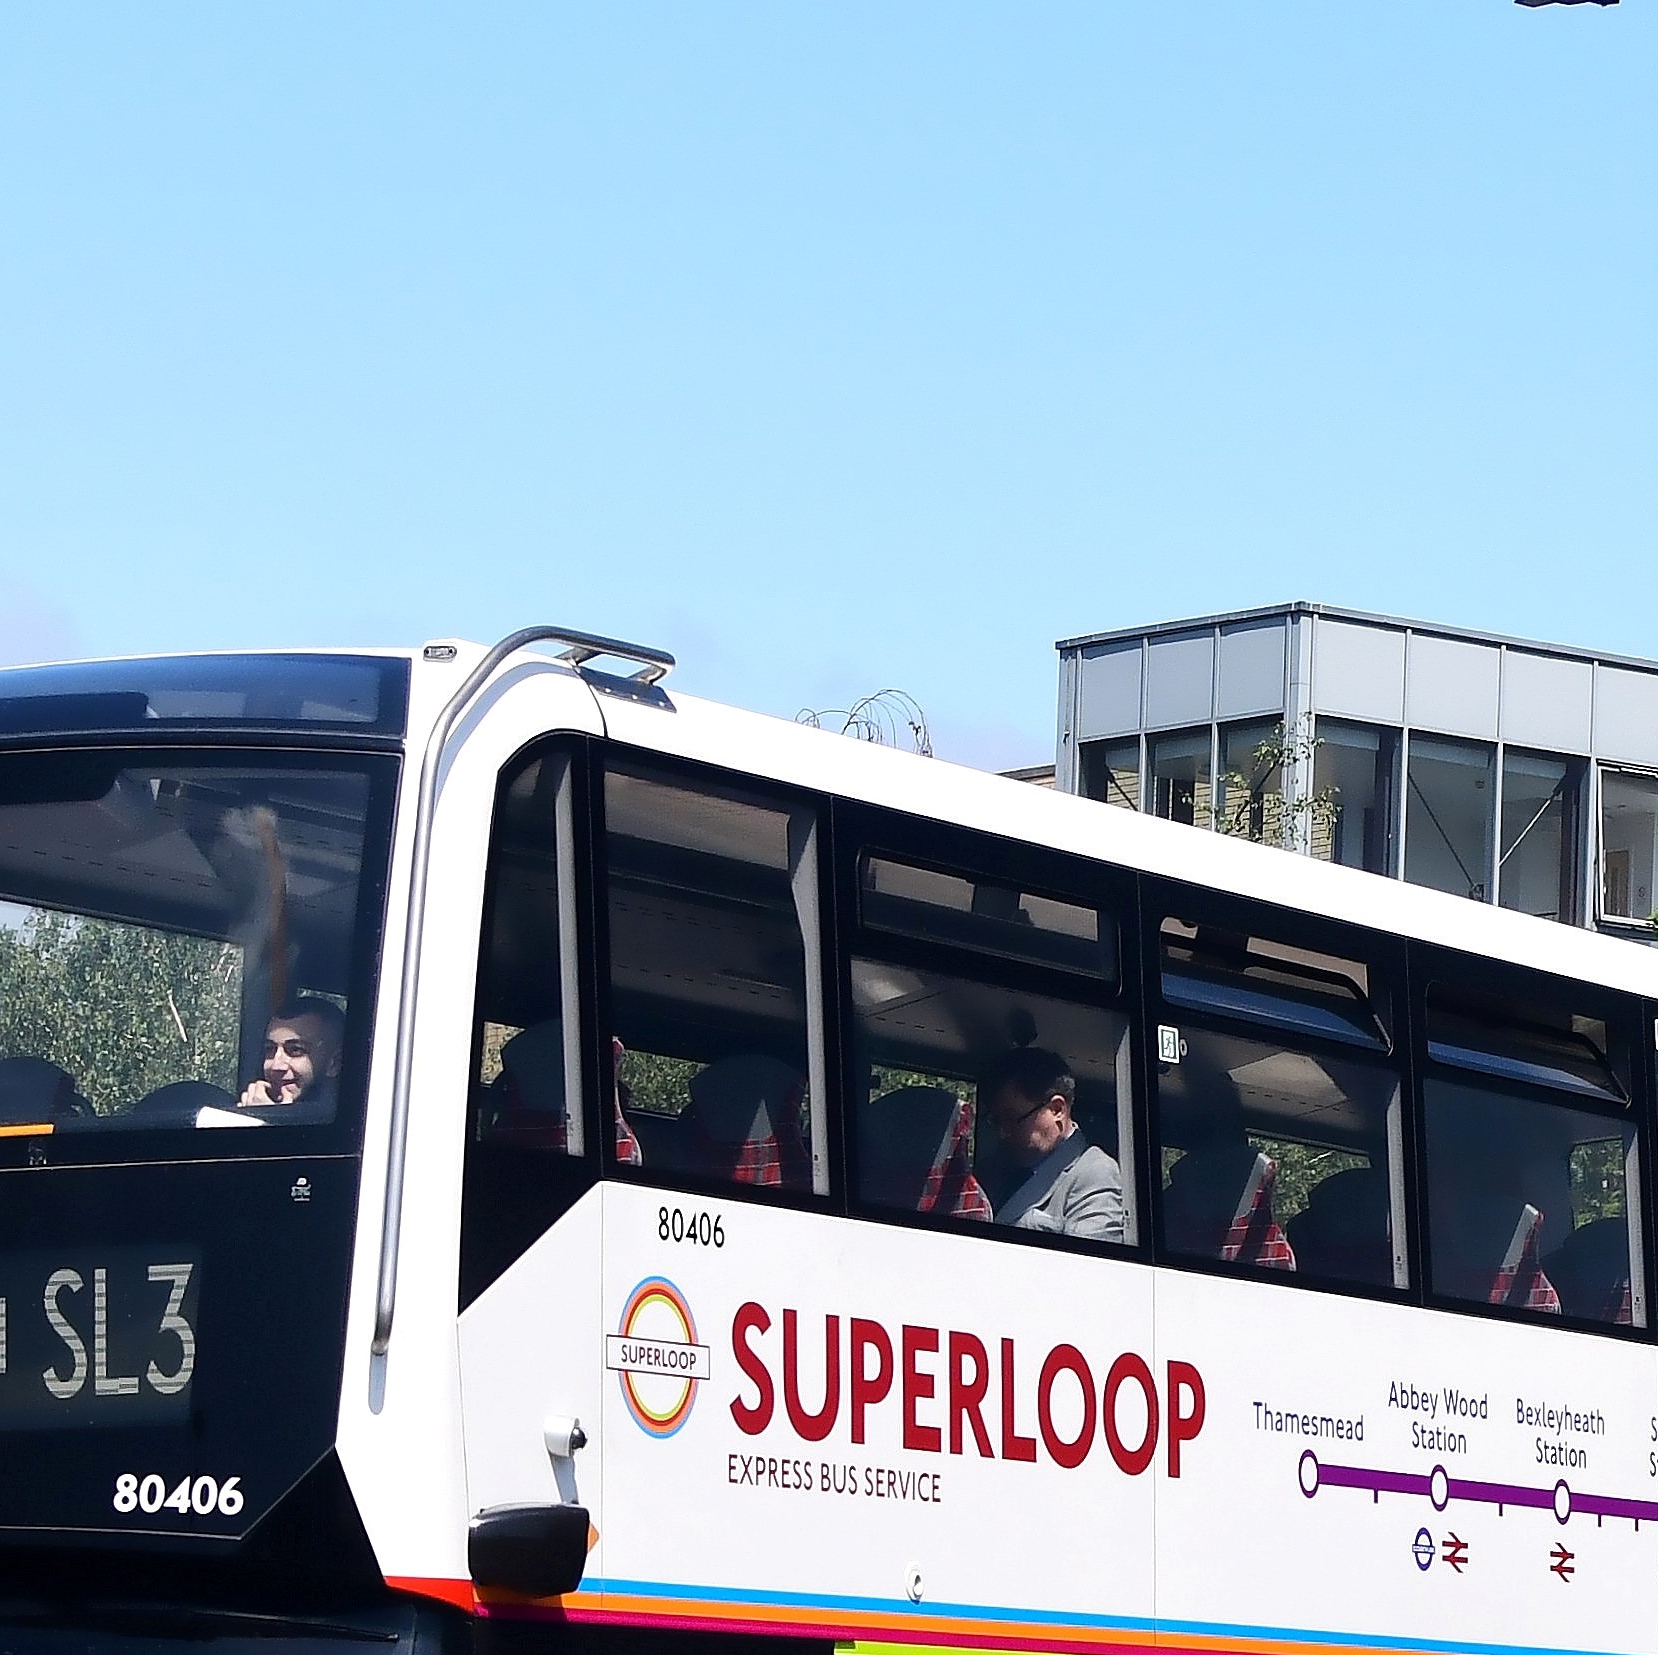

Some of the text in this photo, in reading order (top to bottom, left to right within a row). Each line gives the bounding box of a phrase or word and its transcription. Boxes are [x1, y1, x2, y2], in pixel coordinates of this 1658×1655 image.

[658, 1206, 725, 1248] 80406
[43, 1263, 195, 1400] SL3
[621, 1344, 697, 1370] SUPERLOOP
[730, 1302, 1206, 1479] SUPERLOOP
[1388, 1381, 1488, 1420] Abbey Wood
[1253, 1401, 1364, 1441] Thamesmead
[1516, 1398, 1605, 1436] Bexleyheath
[1412, 1421, 1467, 1454] Station
[1536, 1438, 1587, 1469] Station
[113, 1474, 243, 1516] 80406
[728, 1454, 941, 1502] EXPRESS BUS SERVICE
